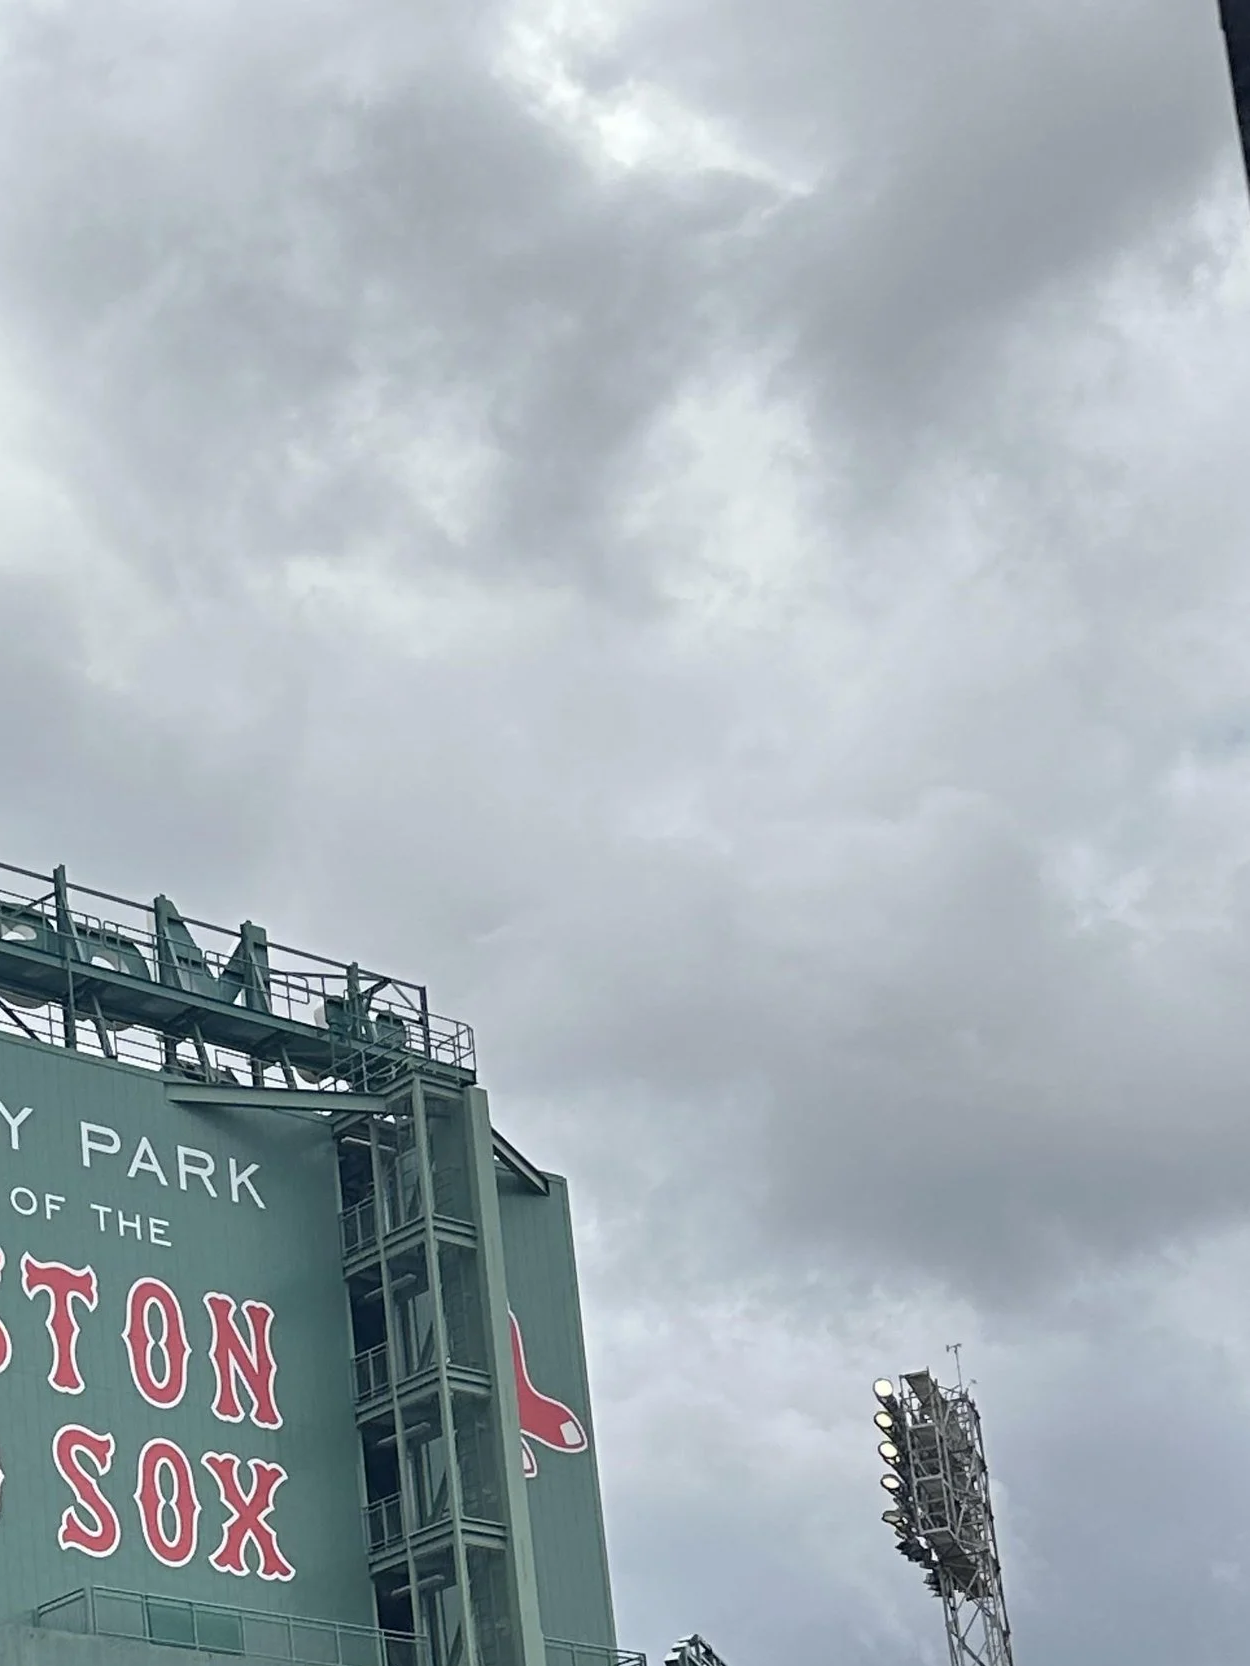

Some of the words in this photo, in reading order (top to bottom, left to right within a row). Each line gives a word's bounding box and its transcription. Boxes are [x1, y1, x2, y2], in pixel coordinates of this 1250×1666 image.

[79, 1121, 266, 1209] PARK
[10, 1186, 65, 1220] OF
[90, 1203, 172, 1247] THE
[51, 1423, 296, 1582] SOX
